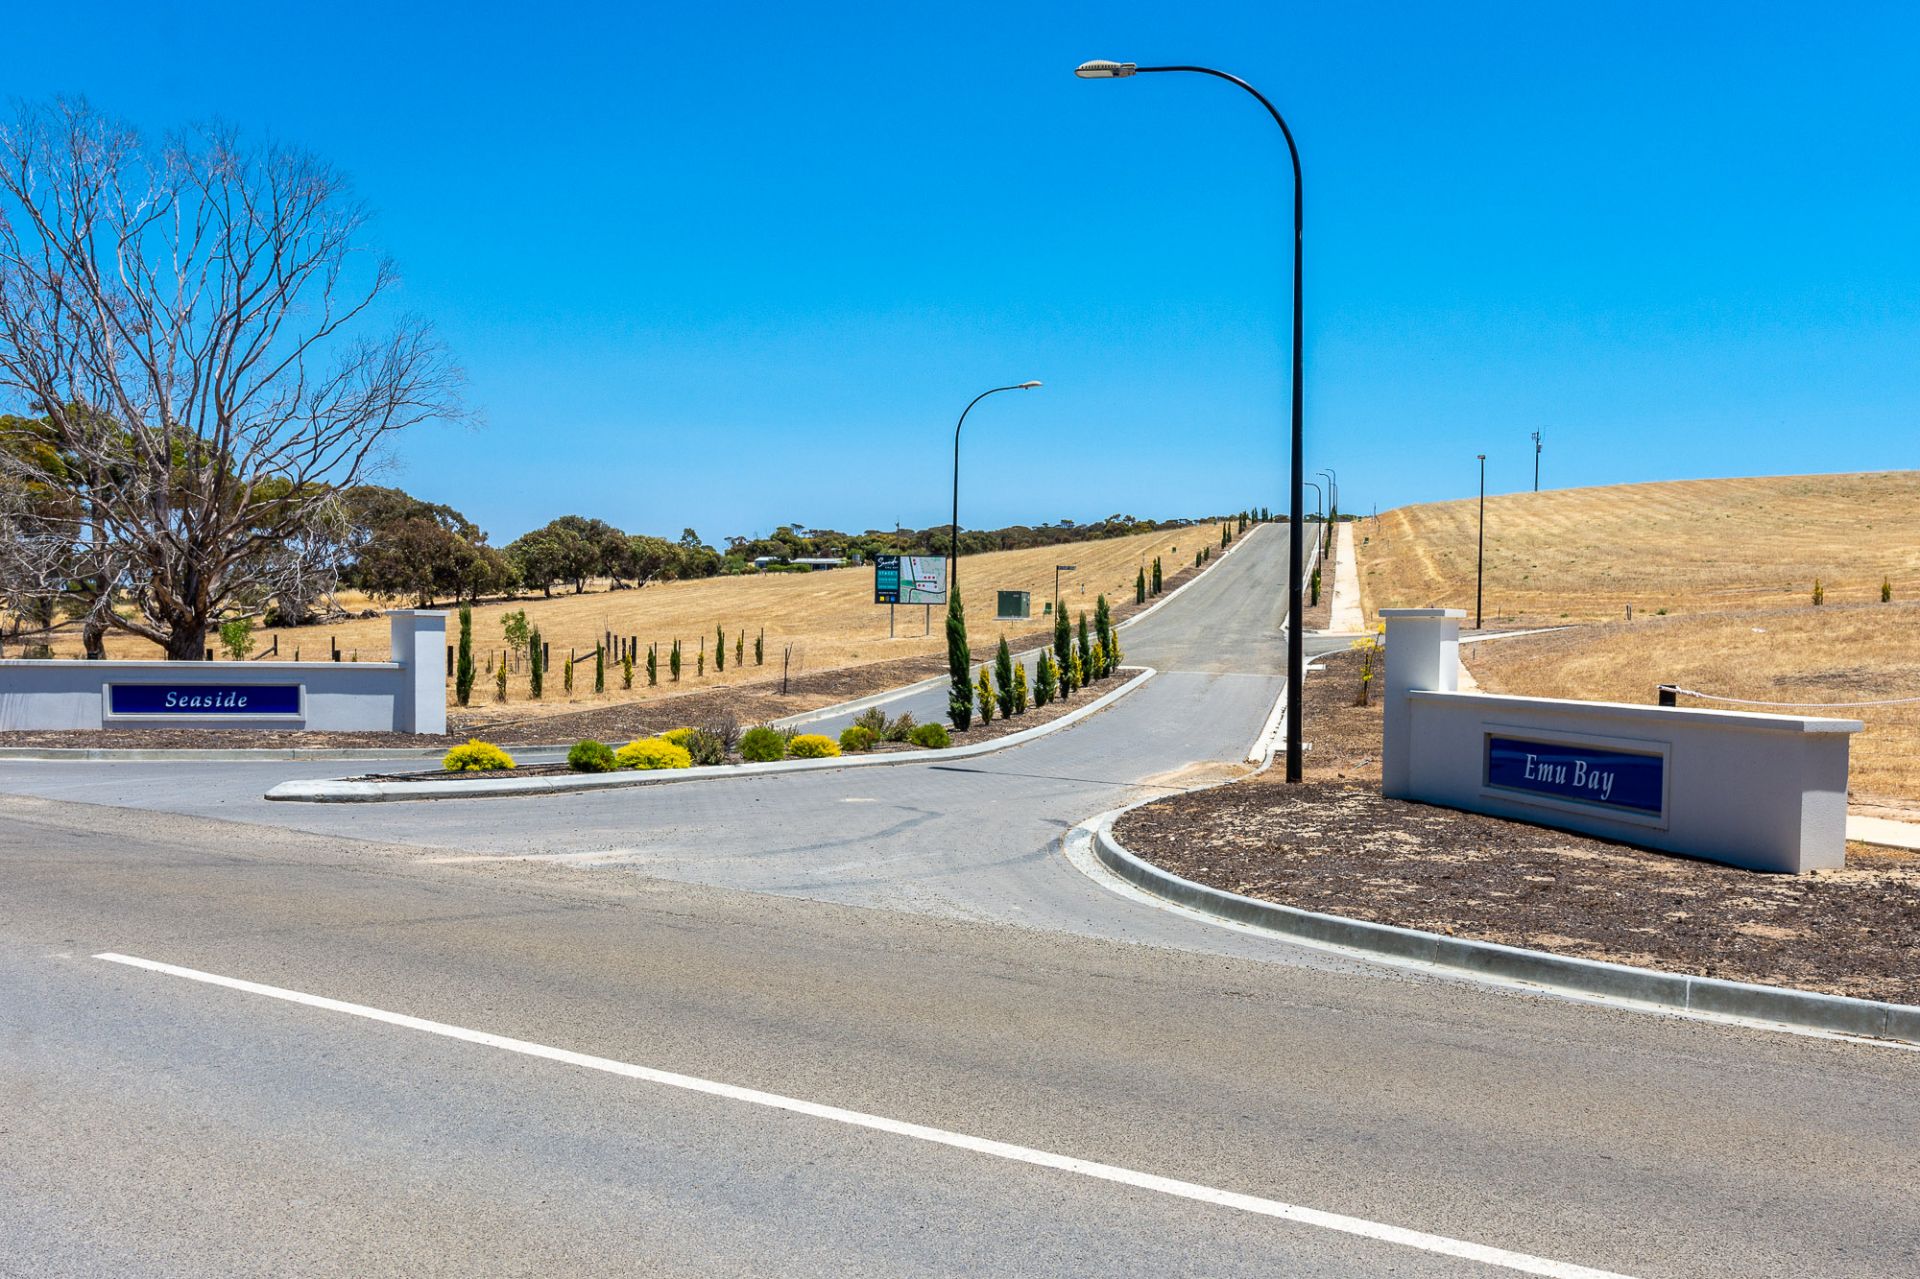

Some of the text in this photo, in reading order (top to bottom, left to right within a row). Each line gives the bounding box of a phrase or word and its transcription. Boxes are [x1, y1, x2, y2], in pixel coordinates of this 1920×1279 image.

[165, 691, 247, 707] Seaside
[1523, 753, 1615, 800] Emu Bay
